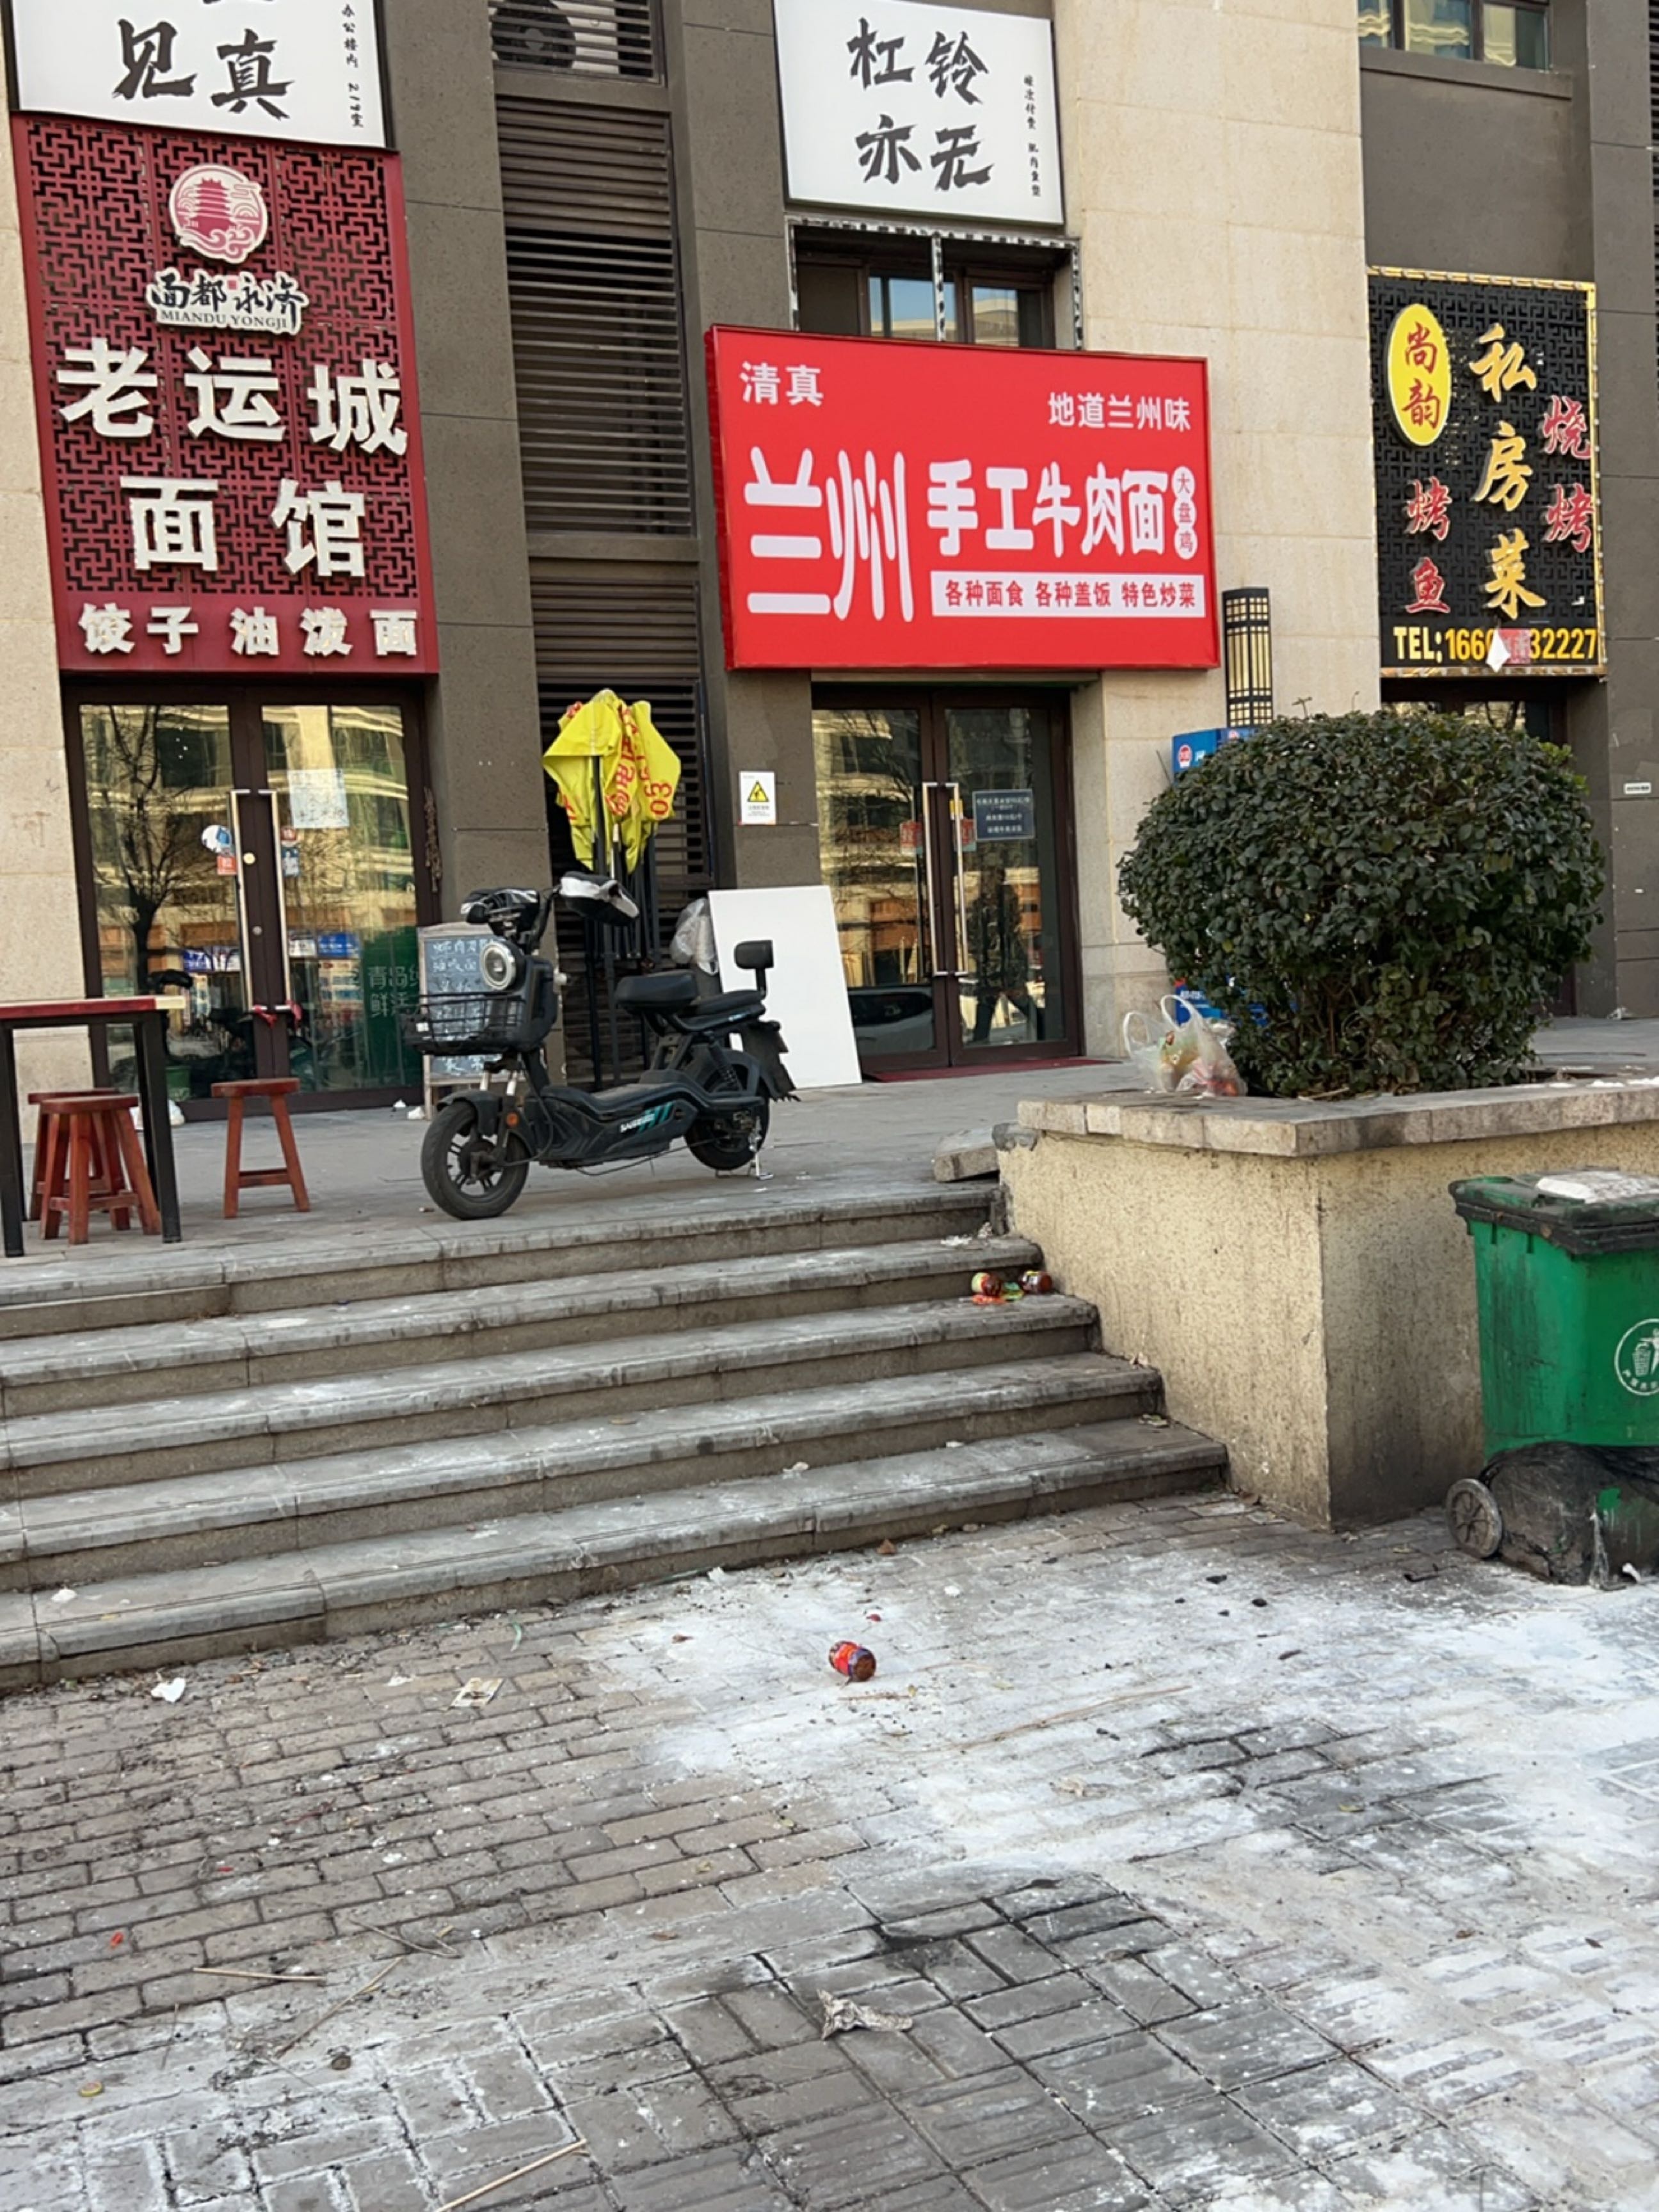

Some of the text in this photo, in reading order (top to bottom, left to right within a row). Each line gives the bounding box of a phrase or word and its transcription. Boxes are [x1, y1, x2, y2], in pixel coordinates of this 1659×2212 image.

[113, 19, 294, 120] 见真
[847, 17, 989, 105] 杠铃
[855, 115, 993, 191] 亦无
[161, 310, 287, 330] MIANDU YONGJI
[57, 337, 408, 456] 老运城
[740, 361, 823, 406] 清真
[1048, 392, 1190, 432] 地道兰州味
[1402, 322, 1440, 429] 尚韵
[1177, 472, 1193, 552] 大盘鸡
[1470, 323, 1546, 620] 私房菜
[1543, 395, 1595, 554] 烧烤
[120, 476, 365, 577] 面馆
[744, 446, 1167, 622] 兰州 手工牛肉面
[1404, 476, 1451, 613] 烤鱼
[945, 579, 1195, 608] 各种面食 各种盖饭 特色炒菜
